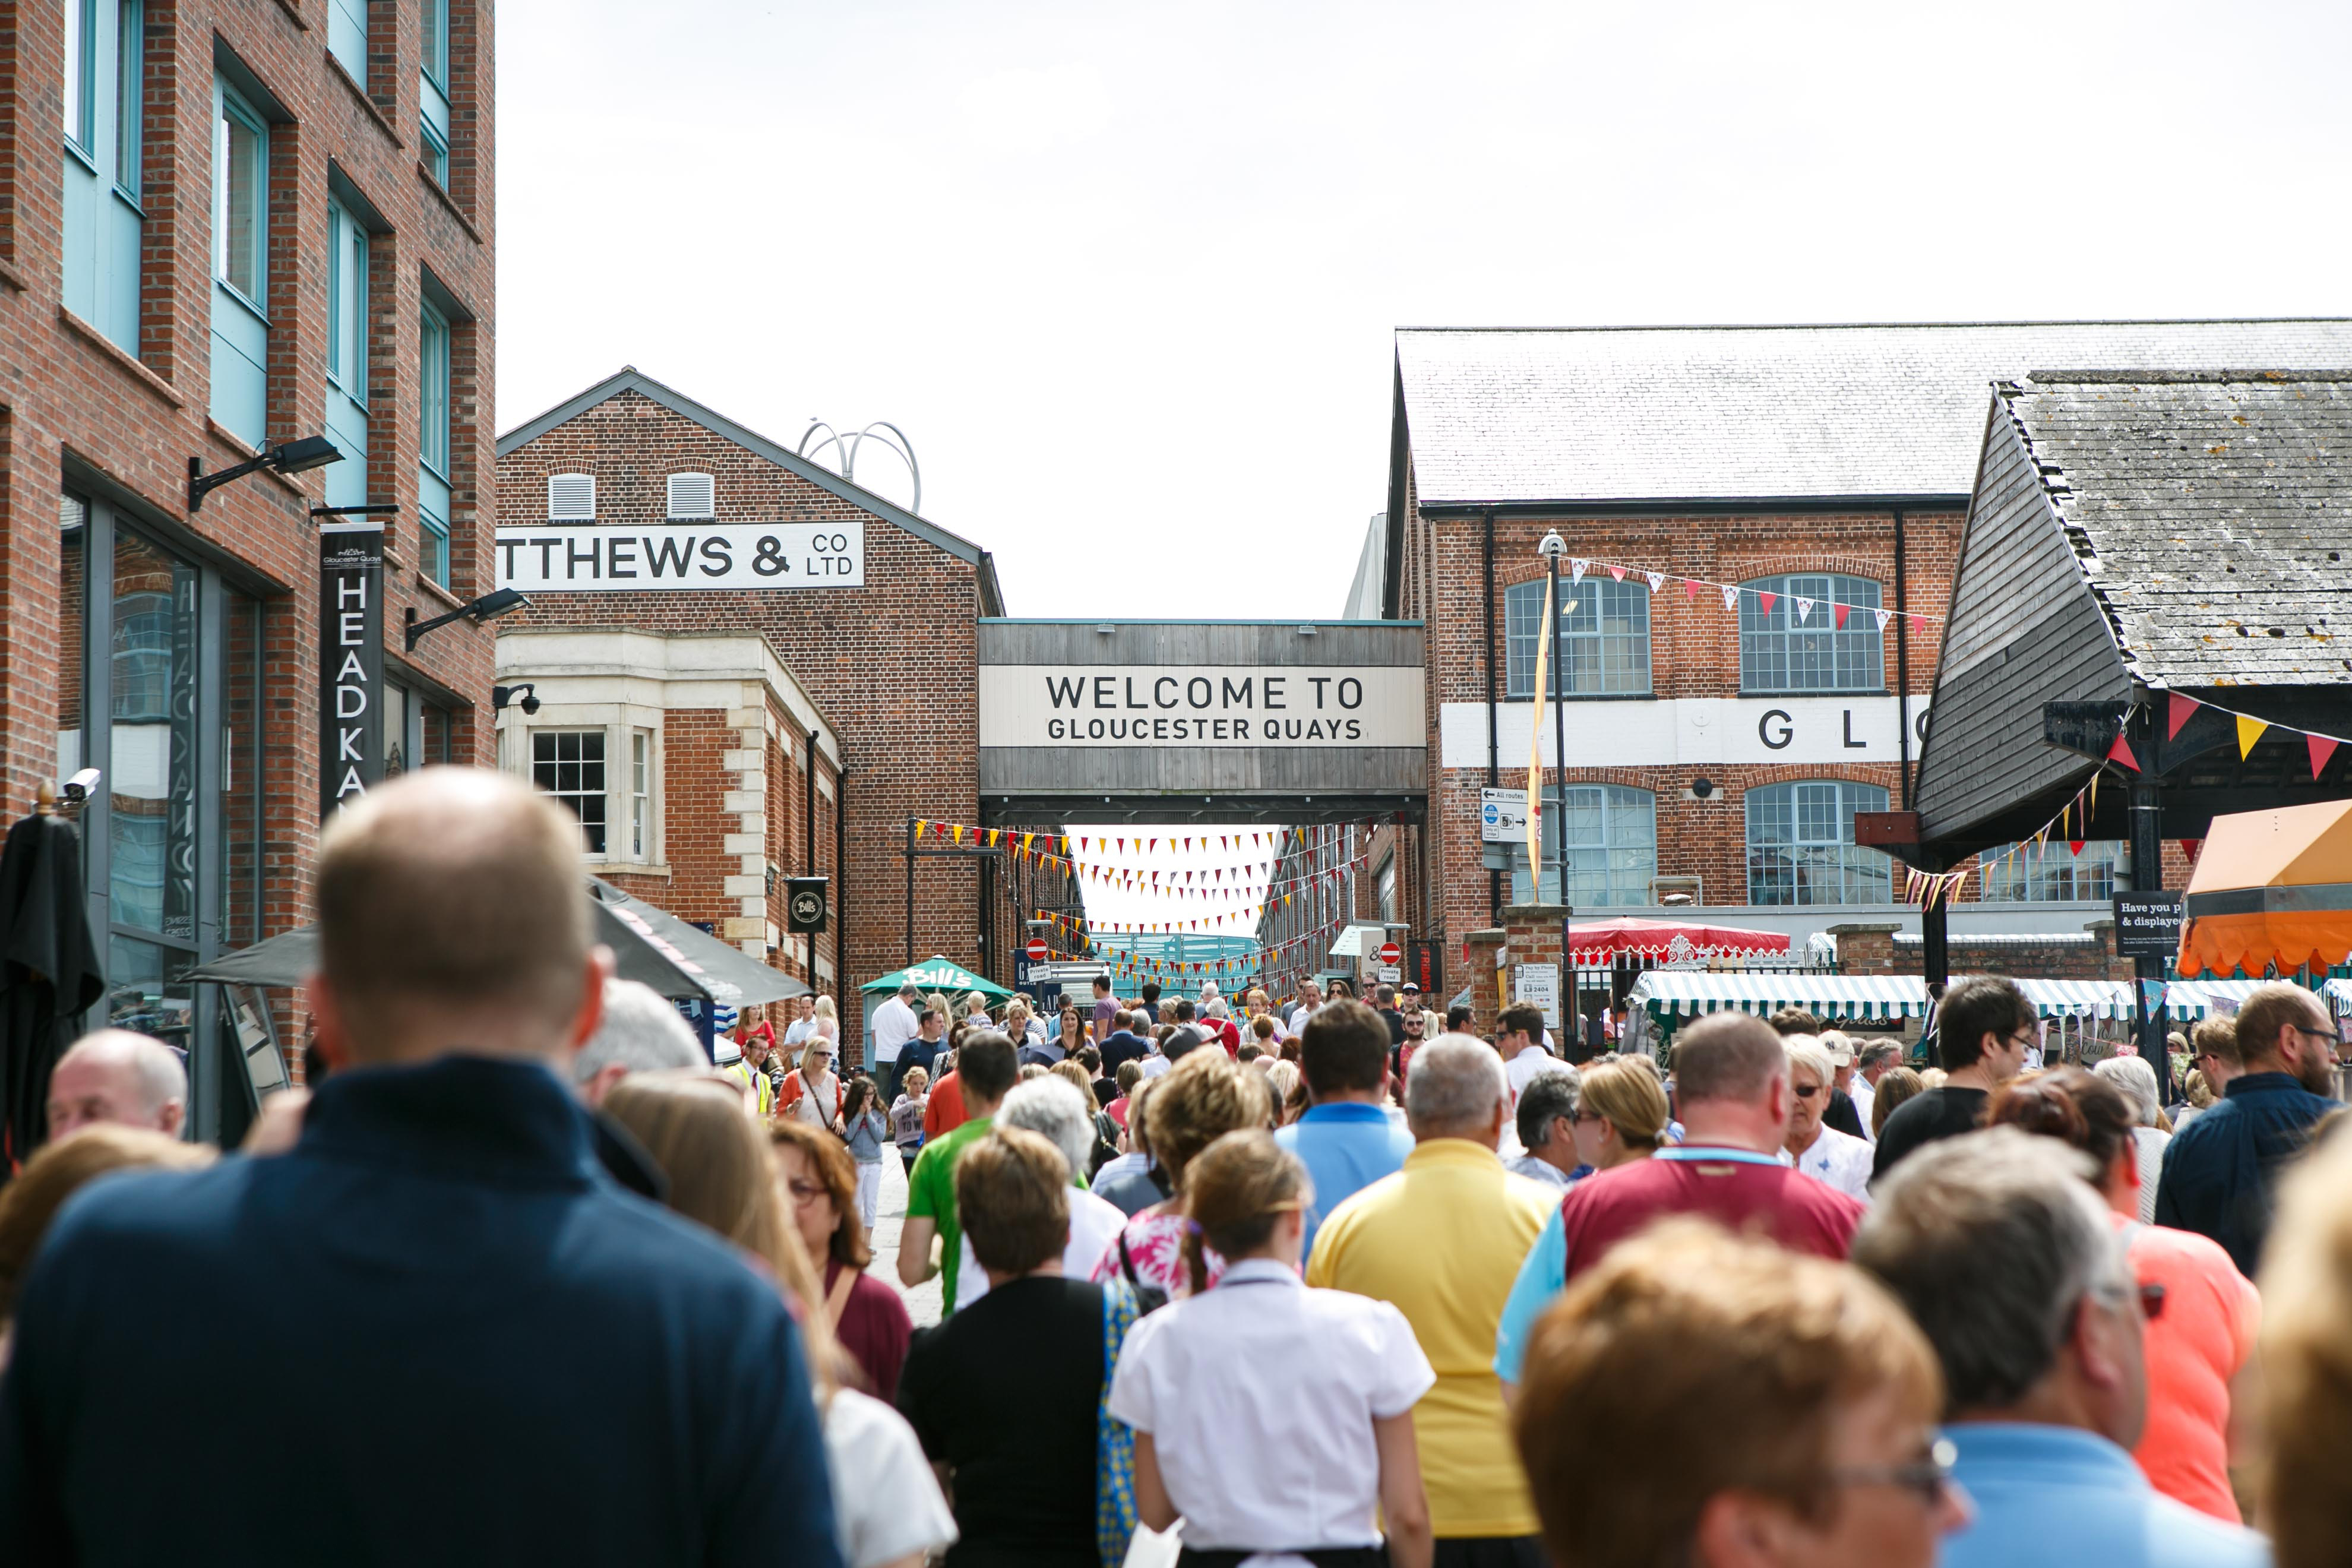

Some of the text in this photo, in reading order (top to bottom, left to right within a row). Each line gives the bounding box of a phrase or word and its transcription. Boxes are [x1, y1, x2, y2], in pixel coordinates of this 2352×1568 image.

[812, 533, 848, 553] CO
[496, 535, 790, 580] TTHEWS &
[807, 557, 852, 576] LTD
[336, 577, 368, 809] HEADKA
[1046, 676, 1363, 710] WELCOME TO
[1048, 718, 1362, 740] GLOUCESTER QUAYS
[798, 900, 815, 913] Bill's
[2121, 903, 2148, 912] Have
[2150, 904, 2170, 914] you
[2122, 916, 2132, 926] &
[902, 967, 972, 987] Bill's
